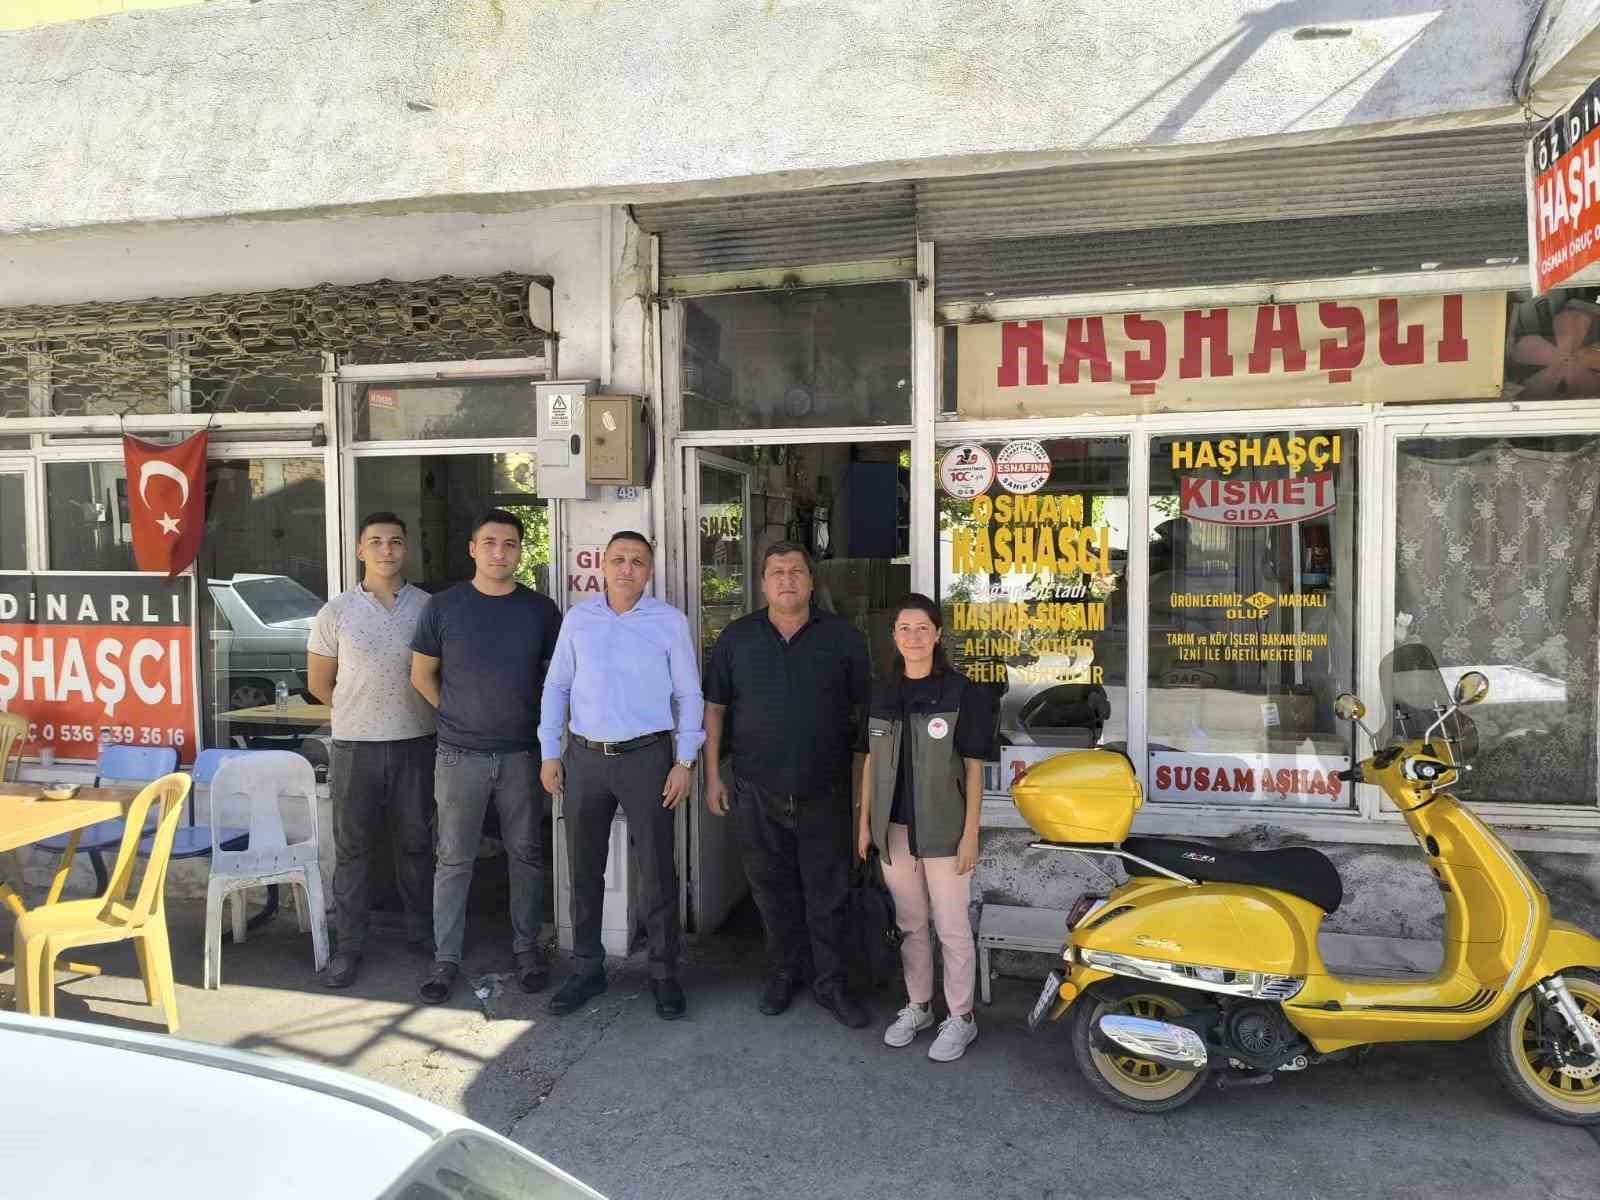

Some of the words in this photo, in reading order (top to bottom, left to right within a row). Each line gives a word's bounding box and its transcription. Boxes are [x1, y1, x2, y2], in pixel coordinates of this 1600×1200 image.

[1540, 134, 1559, 170] ÖZ
[1541, 246, 1568, 275] OSMAN
[1172, 435, 1341, 475] HAŞHAŞÇI
[1181, 473, 1332, 511] KISMET
[972, 494, 1083, 523] OSMAN
[1223, 508, 1280, 521] GIDA
[577, 547, 606, 568] Gİ
[1170, 592, 1243, 608] ÜRÜNLERİMİZ
[1279, 593, 1328, 608] MARKALI
[1226, 609, 1270, 620] OLUP
[1166, 633, 1195, 647] TARIM
[1230, 632, 1259, 648] İŞLERİ
[1179, 647, 1201, 662] İZNİ
[1205, 647, 1221, 662] İLE
[1224, 647, 1313, 662] ÜRETİLMEKTEDİR
[42, 724, 55, 741] 0
[60, 725, 95, 742] 536
[100, 726, 135, 744] 39
[140, 727, 161, 745] 36
[166, 728, 185, 746] 16
[1156, 765, 1255, 793] SUSAM
